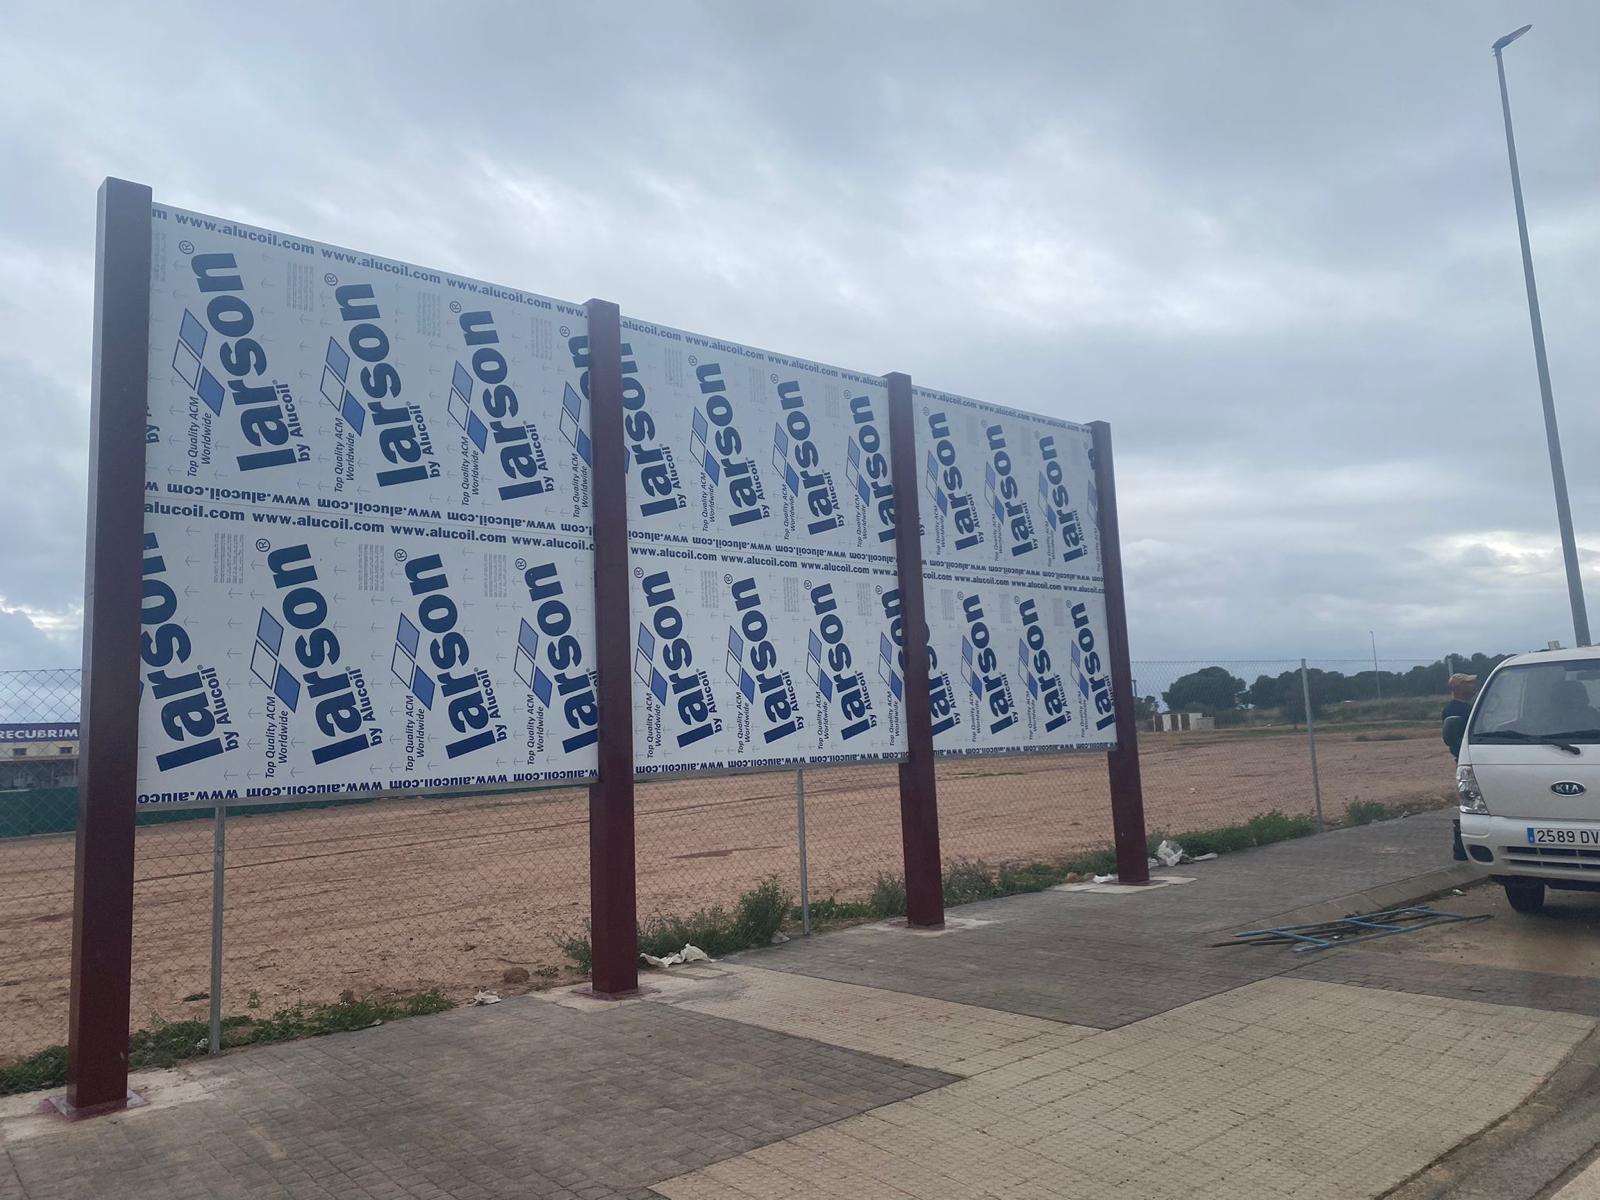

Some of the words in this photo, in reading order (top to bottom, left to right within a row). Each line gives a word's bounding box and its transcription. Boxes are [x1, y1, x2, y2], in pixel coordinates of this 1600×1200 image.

[175, 211, 315, 254] www.alucoil.com
[321, 246, 441, 285] www.alucoil.com
[447, 276, 552, 311] www.alucoil.com
[191, 252, 297, 471] larson
[620, 320, 681, 341] .alucoil.com
[686, 335, 764, 361] www.alucoil.com
[768, 354, 839, 378] www.alucoil.com
[841, 372, 888, 389] www.alucoil
[335, 284, 429, 487] larson
[189, 396, 199, 420] ACM
[276, 383, 303, 438] Alucoil
[459, 310, 544, 501] larson
[188, 422, 200, 457] Quality
[201, 412, 211, 464] Worldwide
[335, 417, 343, 440] ACM
[409, 405, 434, 455] Alucoil
[526, 423, 549, 471] Alucoil
[696, 362, 763, 526] larson
[187, 461, 199, 477] Top
[298, 443, 310, 462] by
[334, 441, 345, 474] Quality
[346, 432, 354, 481] Worldwide
[429, 461, 440, 478] by
[661, 446, 682, 489] Alucoil
[777, 380, 838, 535] larson
[334, 477, 344, 493] Top
[461, 459, 470, 490] Quality
[471, 450, 479, 495] Worldwide
[544, 476, 554, 492] by
[748, 459, 764, 500] Alucoil
[824, 471, 841, 510] Alucoil
[928, 412, 979, 551] larson
[986, 424, 1034, 557] larson
[167, 483, 310, 506] www.alucoil.com
[317, 498, 441, 519] www.alucoil.com
[447, 510, 556, 531] www.alucoil.com
[462, 491, 470, 506] Top
[678, 493, 687, 509] by
[762, 504, 770, 519] by
[1039, 436, 1084, 563] larson
[144, 502, 245, 522] alucoil.com
[252, 512, 385, 534] www.alucoil.com
[391, 524, 507, 545] www.alucoil.com
[512, 535, 596, 551] www.alucoil.c
[631, 546, 717, 562] www.alucoil.com
[721, 555, 798, 569] www.alucoil.com
[801, 561, 870, 575] www.alucoil.com
[692, 536, 772, 553] www.alucoil.com
[775, 545, 847, 558] www.alucoil.com
[267, 543, 370, 766] larson
[405, 553, 496, 760] larson
[642, 570, 715, 748] larson
[731, 577, 797, 744] larson
[810, 583, 871, 741] larson
[962, 594, 1014, 735] larson
[1019, 598, 1067, 733] larson
[1071, 602, 1115, 731] larson
[202, 667, 232, 725] Alucoil
[266, 696, 275, 720] ACM
[351, 668, 376, 722] Alucoil
[406, 695, 414, 717] ACM
[477, 669, 501, 719] Alucoil
[699, 671, 717, 713] Alucoil
[782, 671, 800, 712] Alucoil
[856, 671, 873, 710] Alucoil
[0, 729, 78, 739] RECUBRIM
[265, 722, 277, 758] Quality
[278, 710, 288, 763] Worldwide
[369, 727, 383, 748] by
[405, 719, 415, 753] Quality
[416, 708, 425, 758] Worldwide
[496, 724, 508, 742] by
[526, 717, 536, 748] Quality
[646, 713, 654, 743] Quality
[714, 718, 723, 733] by
[795, 715, 804, 730] by
[869, 713, 878, 728] by
[225, 730, 240, 753] by
[527, 750, 536, 765] Top
[647, 744, 655, 759] Top
[265, 761, 276, 778] Top
[405, 756, 415, 772] Top
[137, 789, 239, 804] www.aluco
[246, 781, 383, 798] www.alucoil.com
[389, 773, 508, 790] www.alucoil.com
[1555, 784, 1579, 793] KIA
[1537, 830, 1575, 843] 2589
